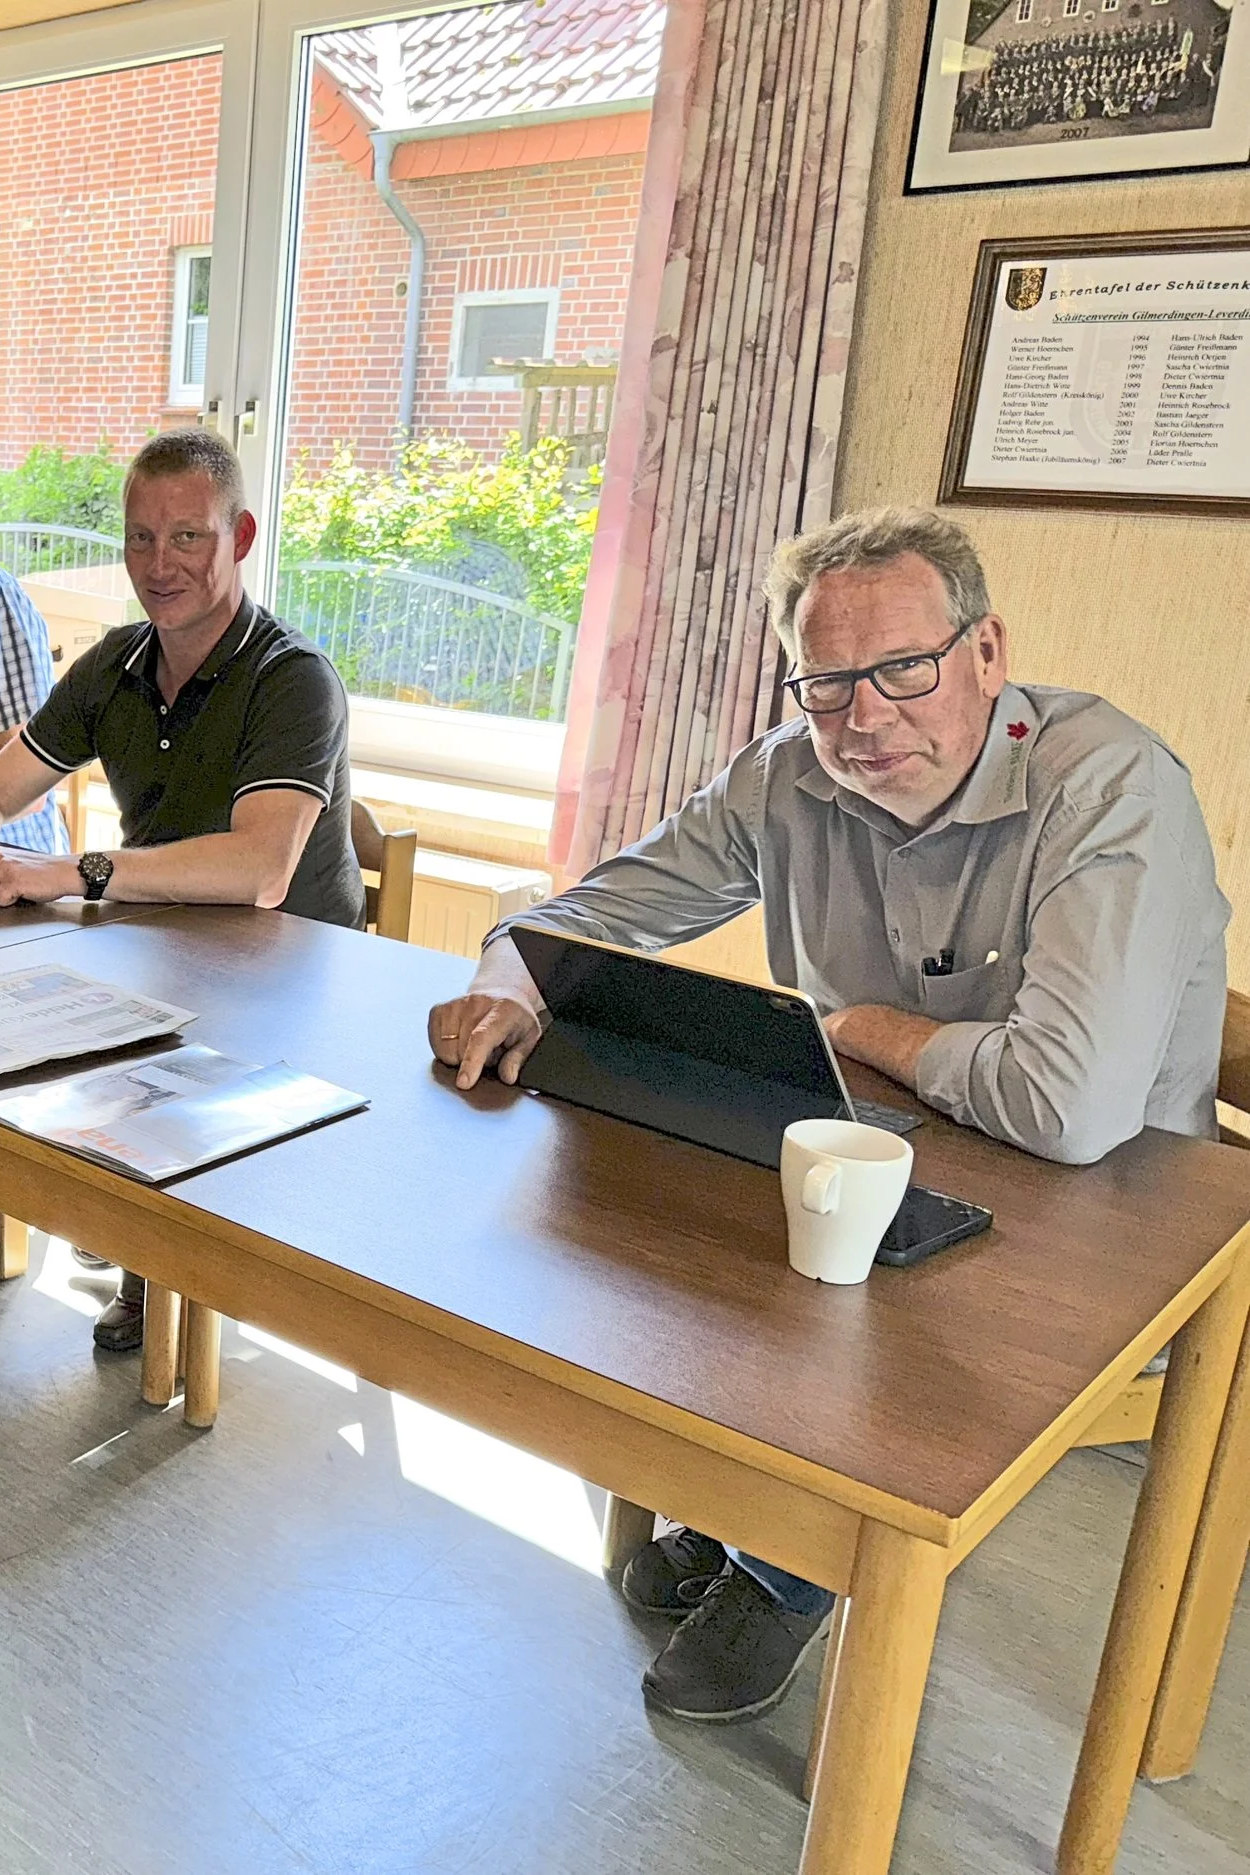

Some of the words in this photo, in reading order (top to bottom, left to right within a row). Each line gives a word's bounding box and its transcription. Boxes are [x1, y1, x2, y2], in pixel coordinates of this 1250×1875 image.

[1060, 127, 1090, 139] 2007
[1135, 282, 1161, 292] der
[1052, 312, 1129, 323] Schützenverein
[1219, 333, 1244, 341] Baden
[1131, 344, 1148, 352] 1995
[1127, 363, 1145, 371] 1997
[1005, 373, 1046, 381] Hans-Georg
[1190, 382, 1214, 390] Baden
[1117, 410, 1135, 418] 2002
[1185, 412, 1210, 420] Jaeger
[1115, 420, 1133, 428] 2003
[1146, 458, 1169, 466] Dieter
